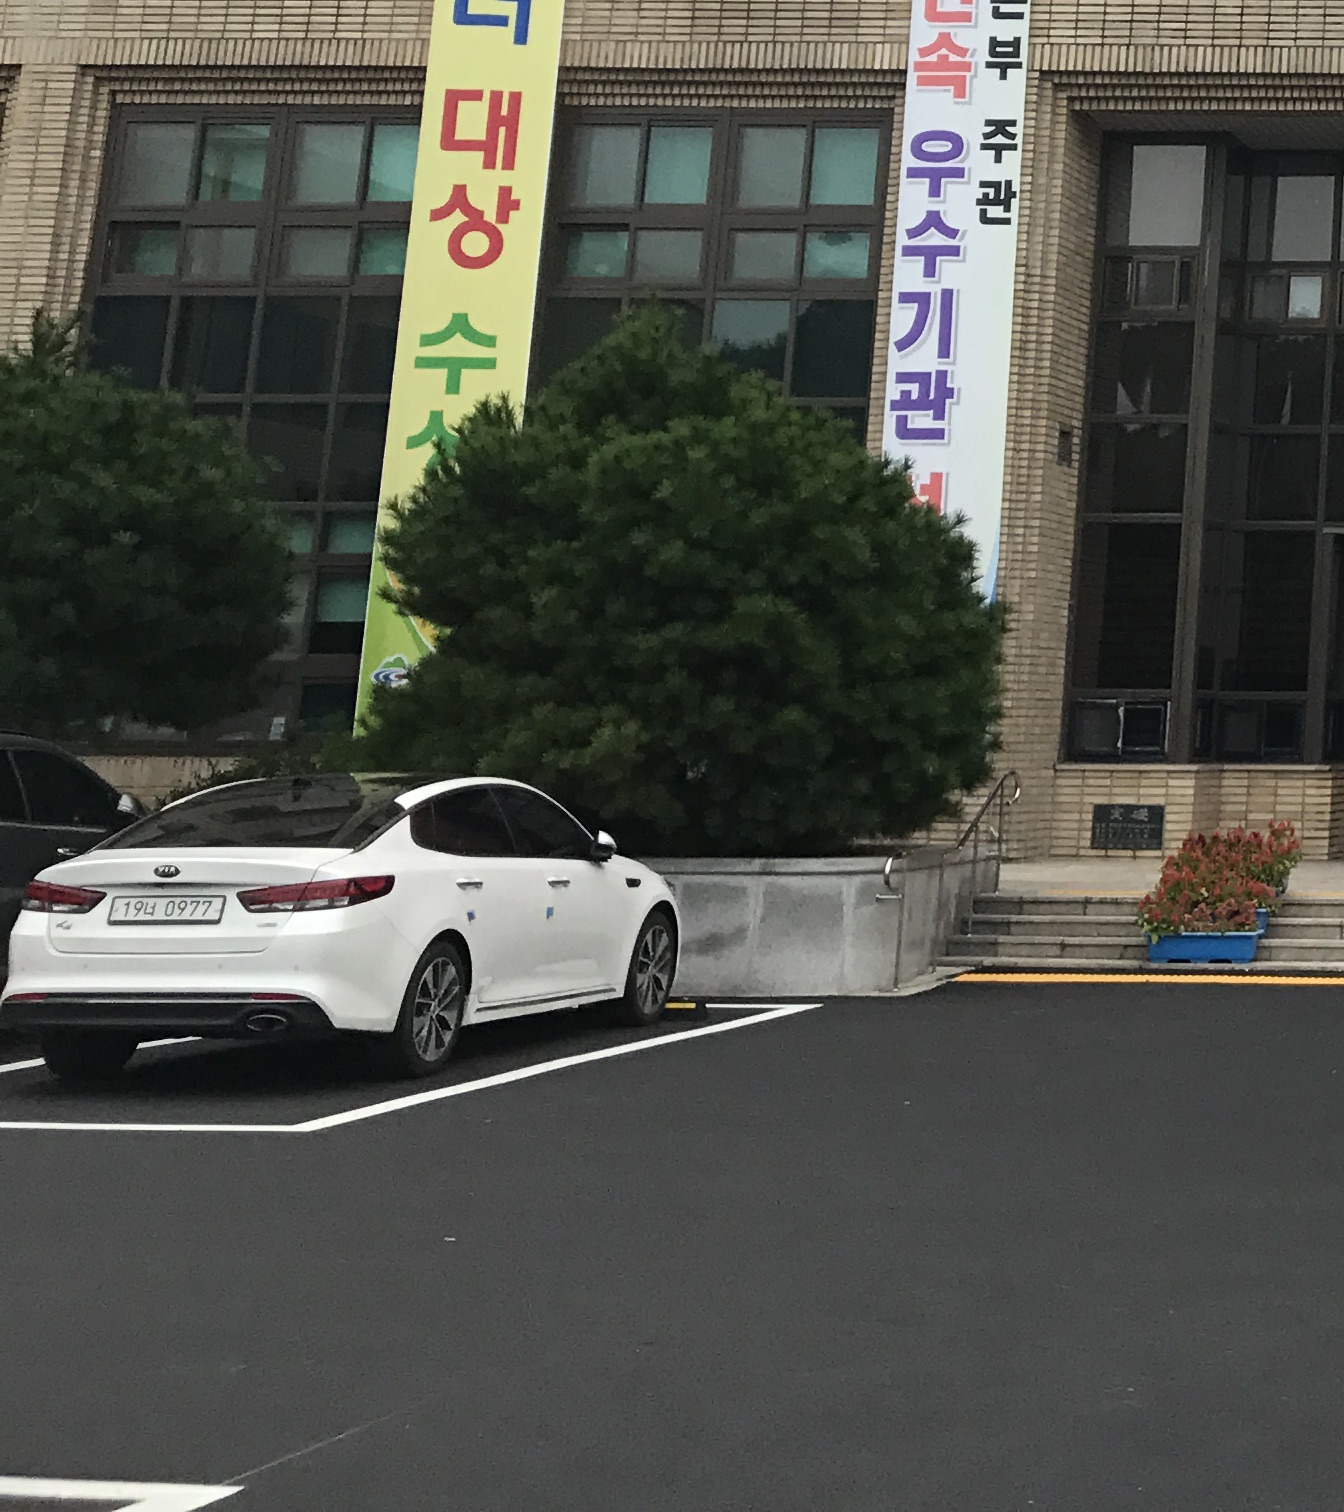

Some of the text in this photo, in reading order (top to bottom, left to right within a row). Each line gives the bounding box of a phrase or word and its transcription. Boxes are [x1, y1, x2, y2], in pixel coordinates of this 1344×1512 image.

[428, 88, 523, 270] 대상
[975, 118, 1019, 226] 주관
[889, 129, 965, 441] 우수기관
[164, 899, 214, 917] 0977
